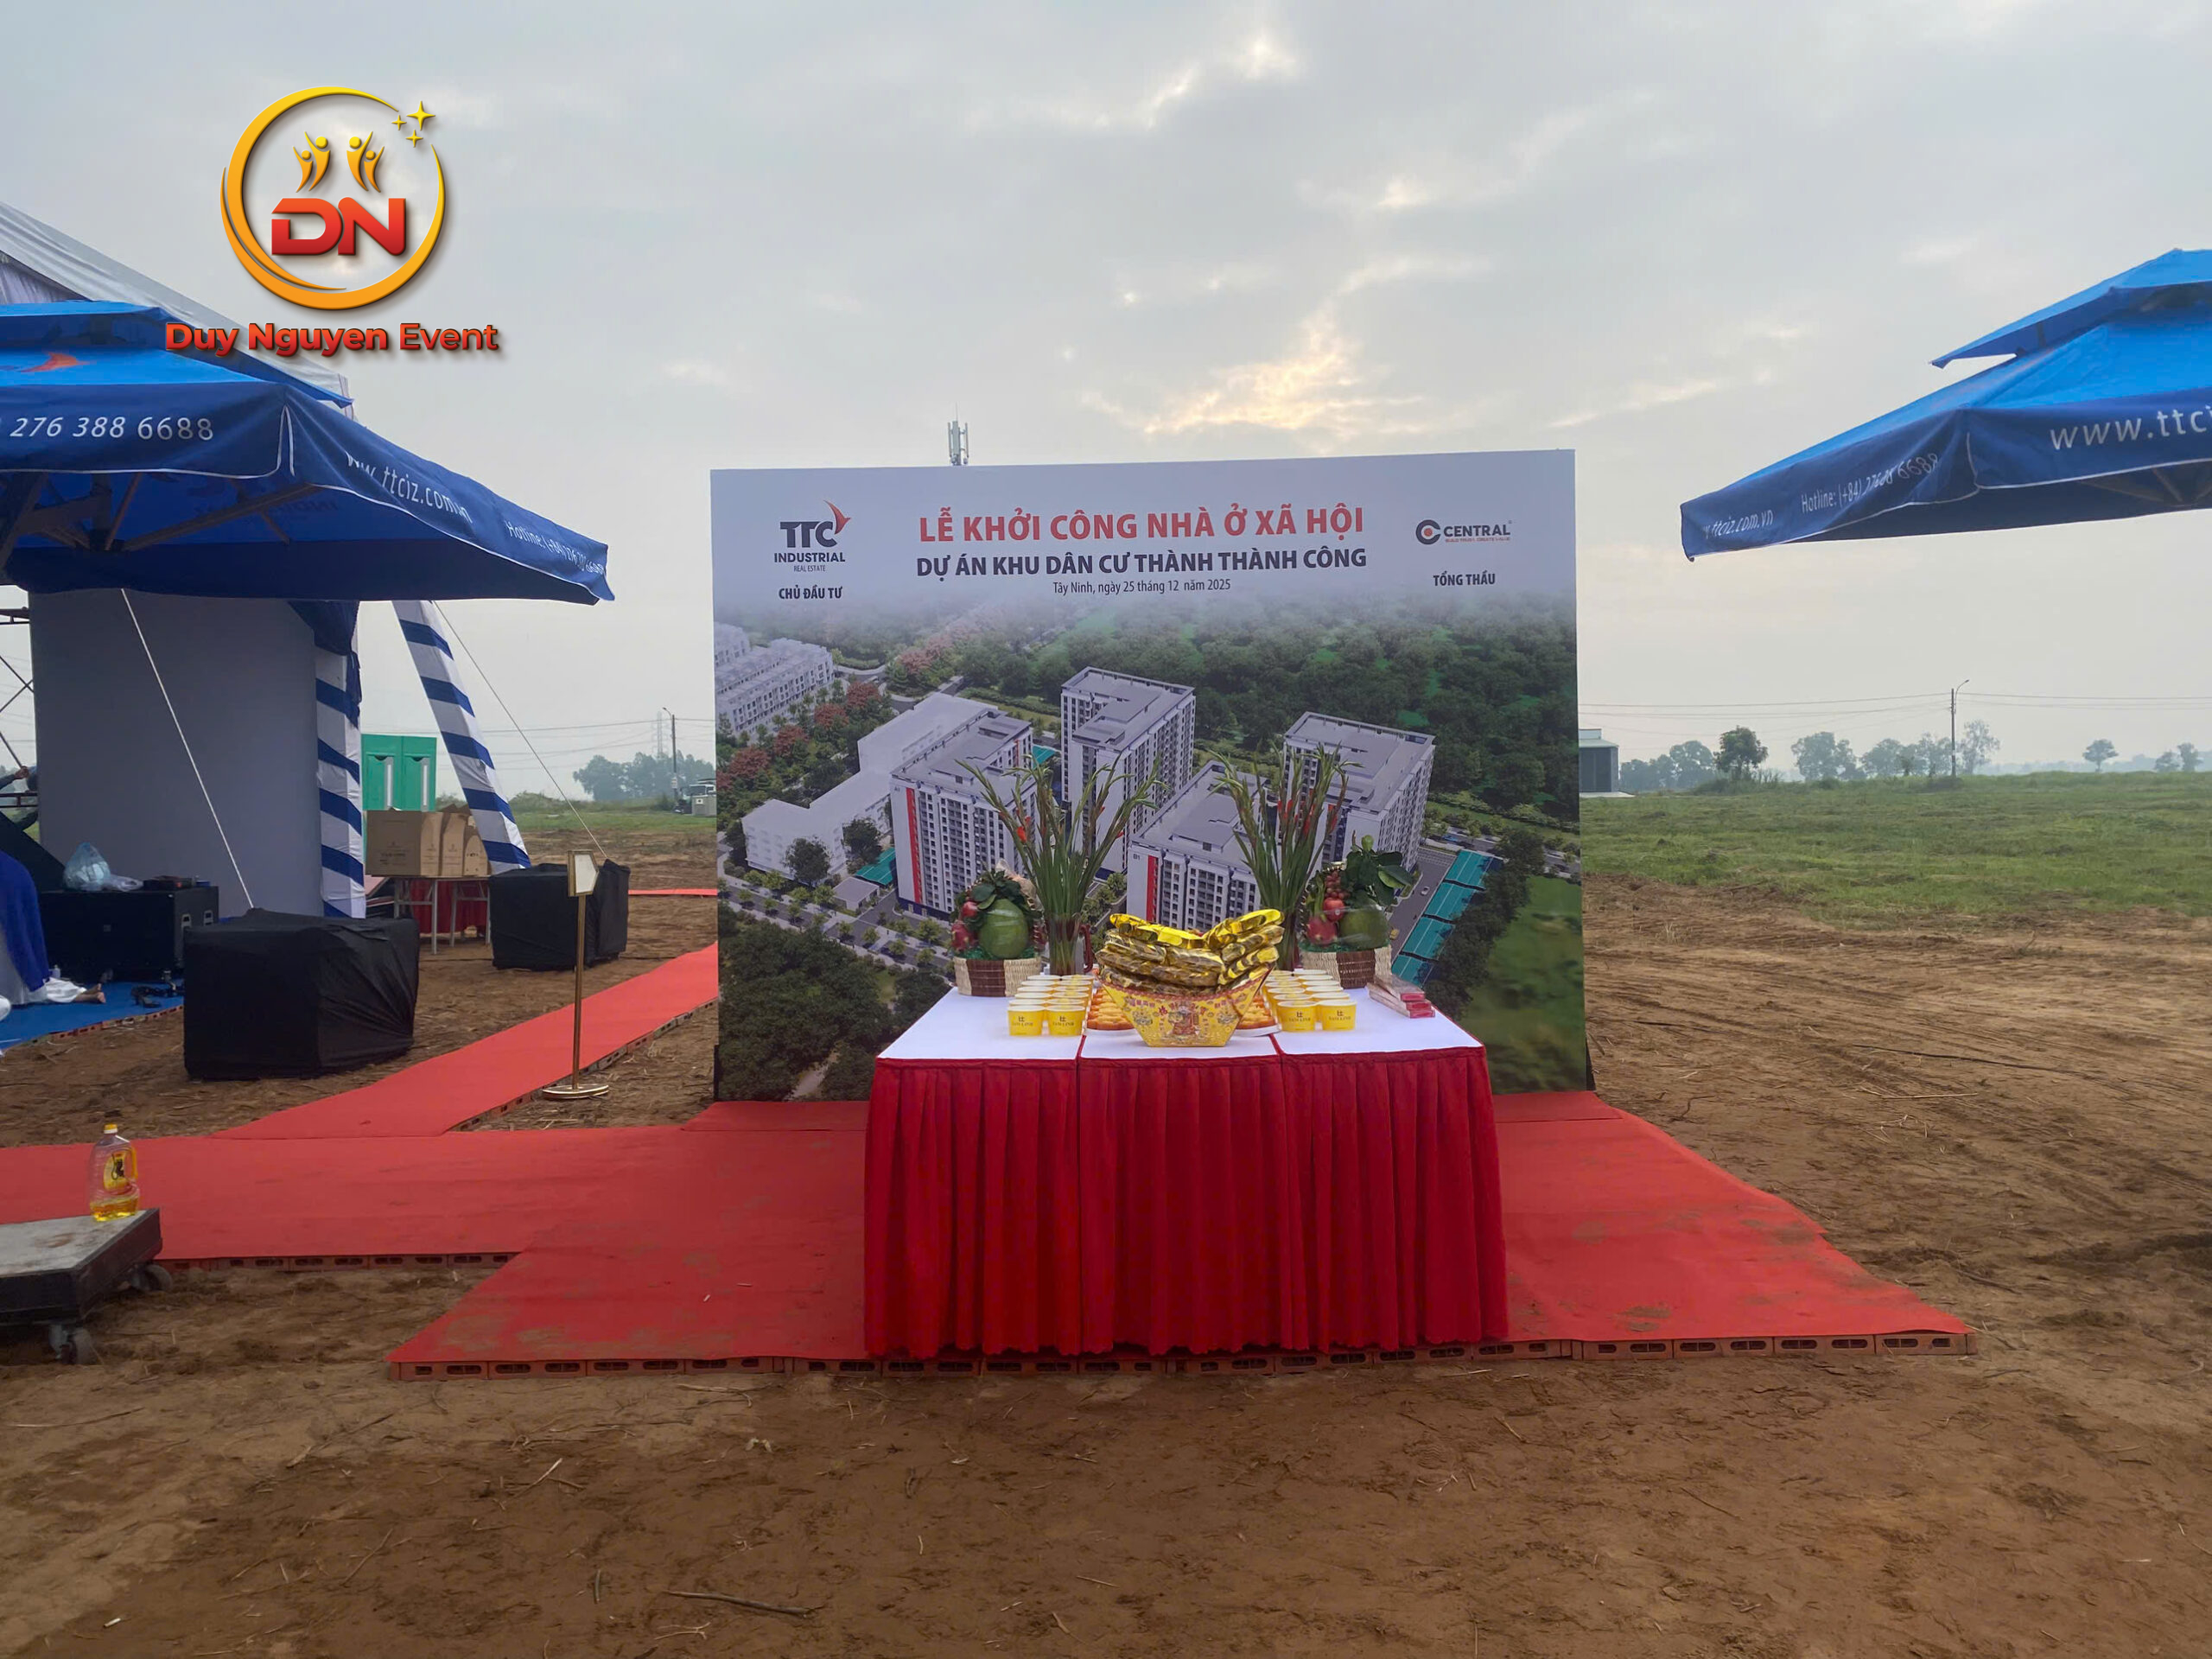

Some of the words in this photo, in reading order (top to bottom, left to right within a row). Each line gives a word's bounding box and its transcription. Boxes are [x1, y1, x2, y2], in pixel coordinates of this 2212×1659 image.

[10, 416, 63, 437] 276
[73, 416, 126, 438] 388
[137, 416, 213, 440] 6688
[1802, 489, 1836, 514] Hotline:
[1838, 478, 1862, 509] (+84)
[919, 506, 954, 542] LỄ
[963, 507, 1040, 542] KHỞI
[1050, 509, 1137, 540] CÔNG
[1147, 506, 1215, 538] NHÀ
[1224, 502, 1248, 537] Ở
[1255, 503, 1296, 535] XÃ
[1306, 502, 1363, 541] HỘI
[1443, 524, 1511, 537] CENTRAL
[779, 521, 837, 548] TTC
[774, 551, 846, 563] INDUSTRIAL
[917, 555, 951, 582] DỰ
[956, 553, 987, 575] ÁN
[993, 556, 1039, 575] KHU
[1046, 551, 1093, 575] DÂN
[1098, 551, 1130, 574] CƯ
[1135, 550, 1212, 573] THÀNH
[1218, 547, 1297, 570] THÀNH
[1303, 545, 1367, 569] CÔNG
[1052, 582, 1068, 595] Tây
[1071, 582, 1096, 594] Ninh,
[1098, 582, 1121, 595] ngày
[1123, 582, 1135, 593] 25
[1137, 580, 1165, 594] tháng
[1167, 580, 1179, 592] 12
[1184, 579, 1205, 591] năm
[1207, 579, 1231, 590] 2025
[1433, 570, 1463, 587] TỔNG
[779, 584, 800, 600] CHỦ
[828, 586, 843, 599] TƯ
